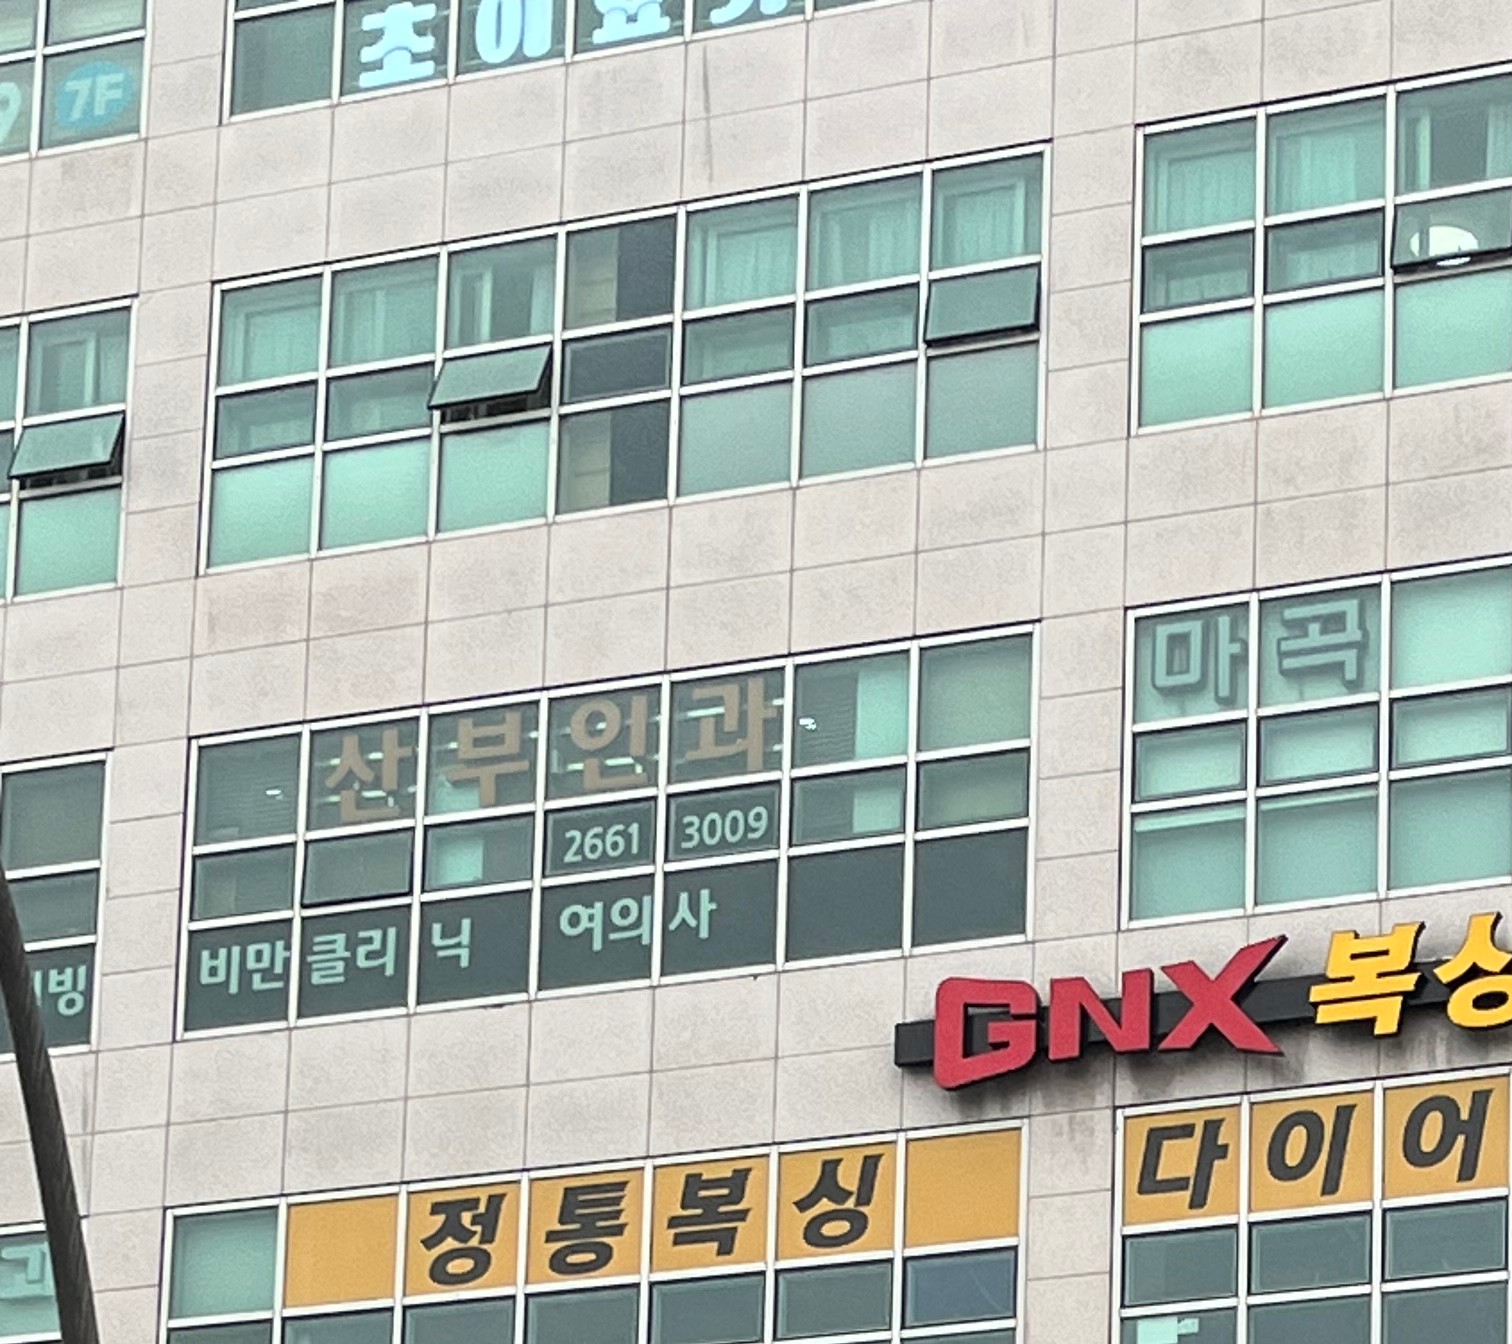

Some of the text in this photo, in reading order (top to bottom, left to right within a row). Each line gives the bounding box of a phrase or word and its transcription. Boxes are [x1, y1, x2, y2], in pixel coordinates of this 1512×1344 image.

[64, 72, 125, 122] 7F
[1152, 598, 1370, 706] 마곡
[327, 678, 779, 825] 산부인과
[563, 805, 769, 864] 2661 3009
[559, 889, 717, 954] 여의사
[932, 936, 1289, 1092] GNX
[420, 1151, 887, 1288] 정통복싱
